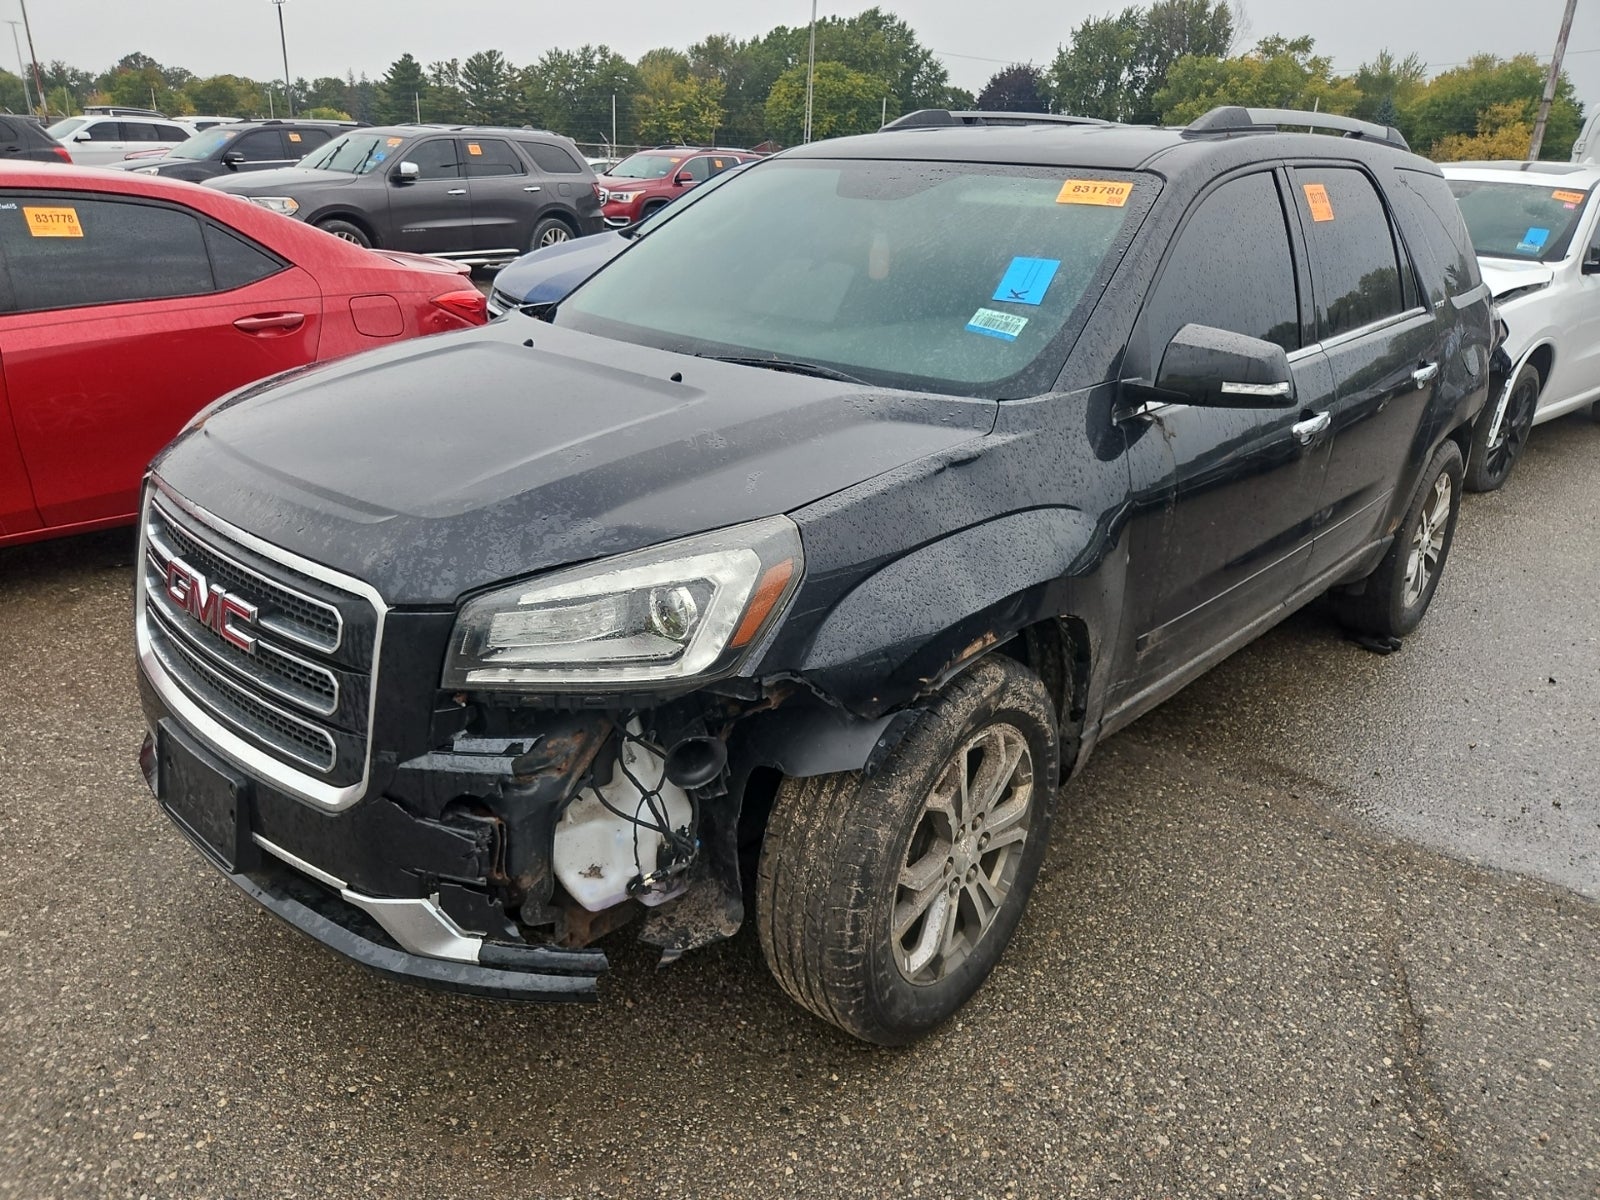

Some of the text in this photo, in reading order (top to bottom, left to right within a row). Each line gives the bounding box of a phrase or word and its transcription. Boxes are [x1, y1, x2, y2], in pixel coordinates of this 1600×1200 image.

[1072, 185, 1124, 195] 831780
[34, 213, 75, 224] 831778
[167, 557, 258, 656] GMC
